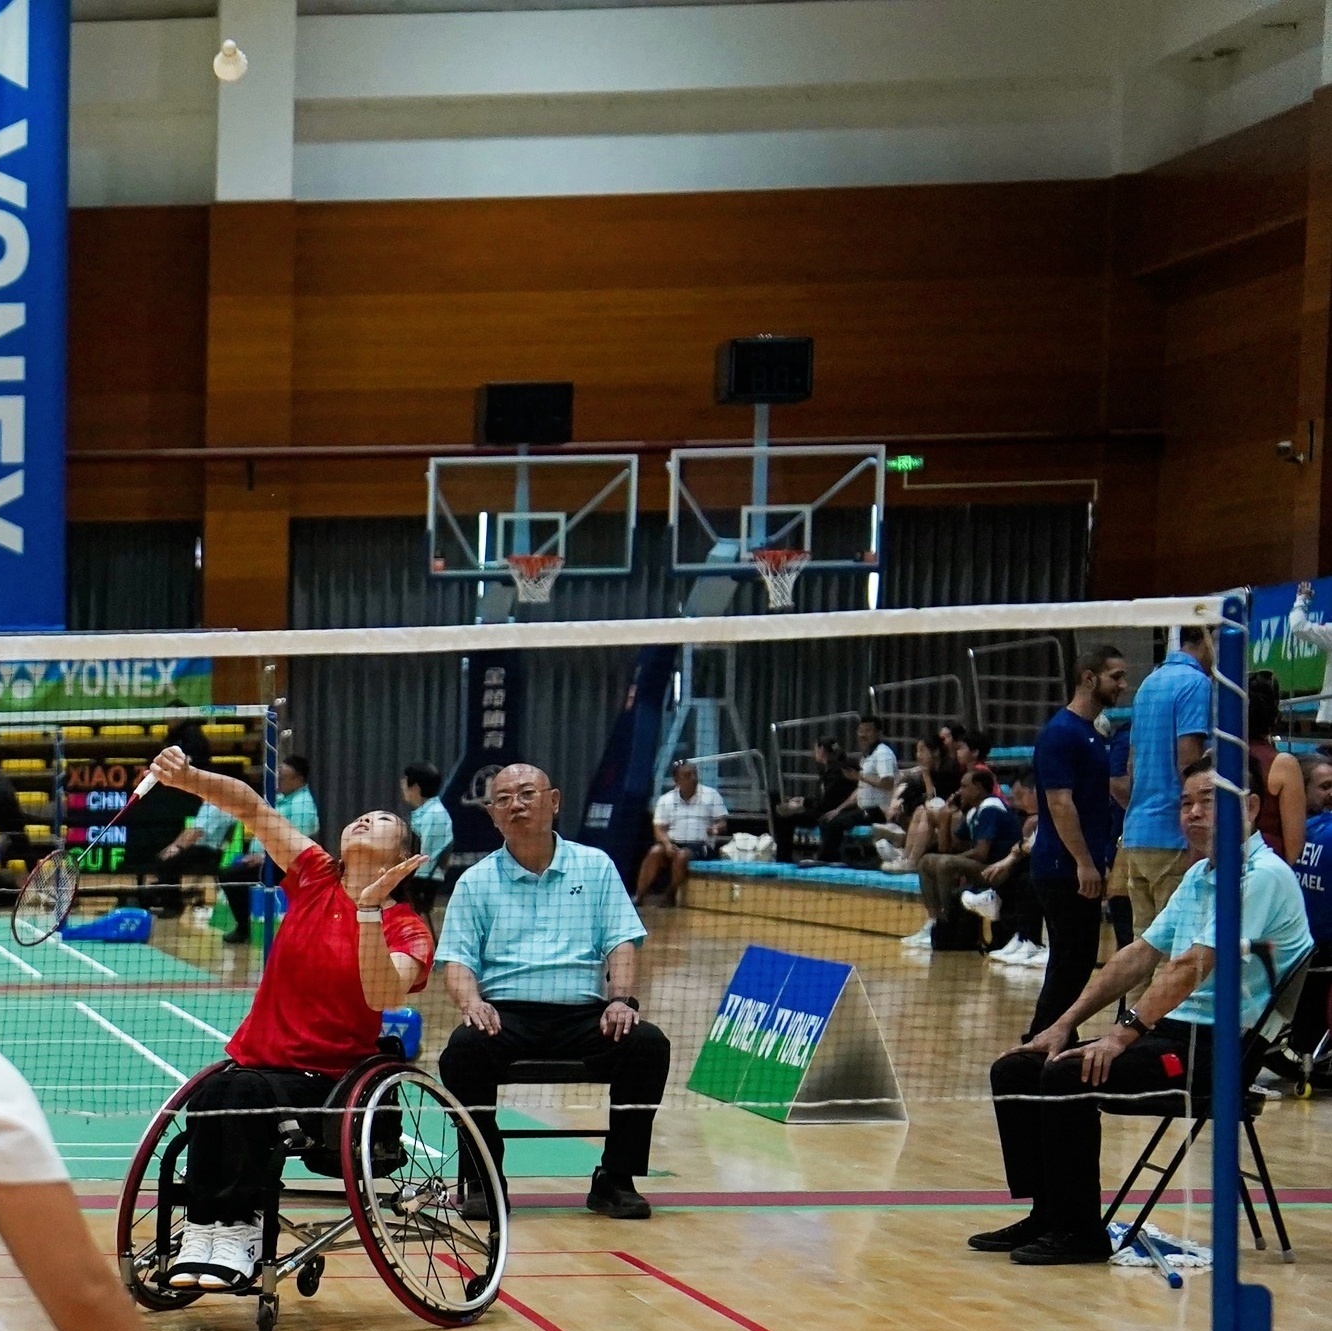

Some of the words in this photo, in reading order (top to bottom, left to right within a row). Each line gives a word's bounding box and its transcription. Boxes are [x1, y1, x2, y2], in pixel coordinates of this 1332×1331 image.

[59, 659, 178, 697] YONEX
[86, 791, 127, 811] CHN
[1296, 842, 1324, 867] EVI
[726, 998, 770, 1053] YONEX
[776, 1011, 825, 1068] YONEX
